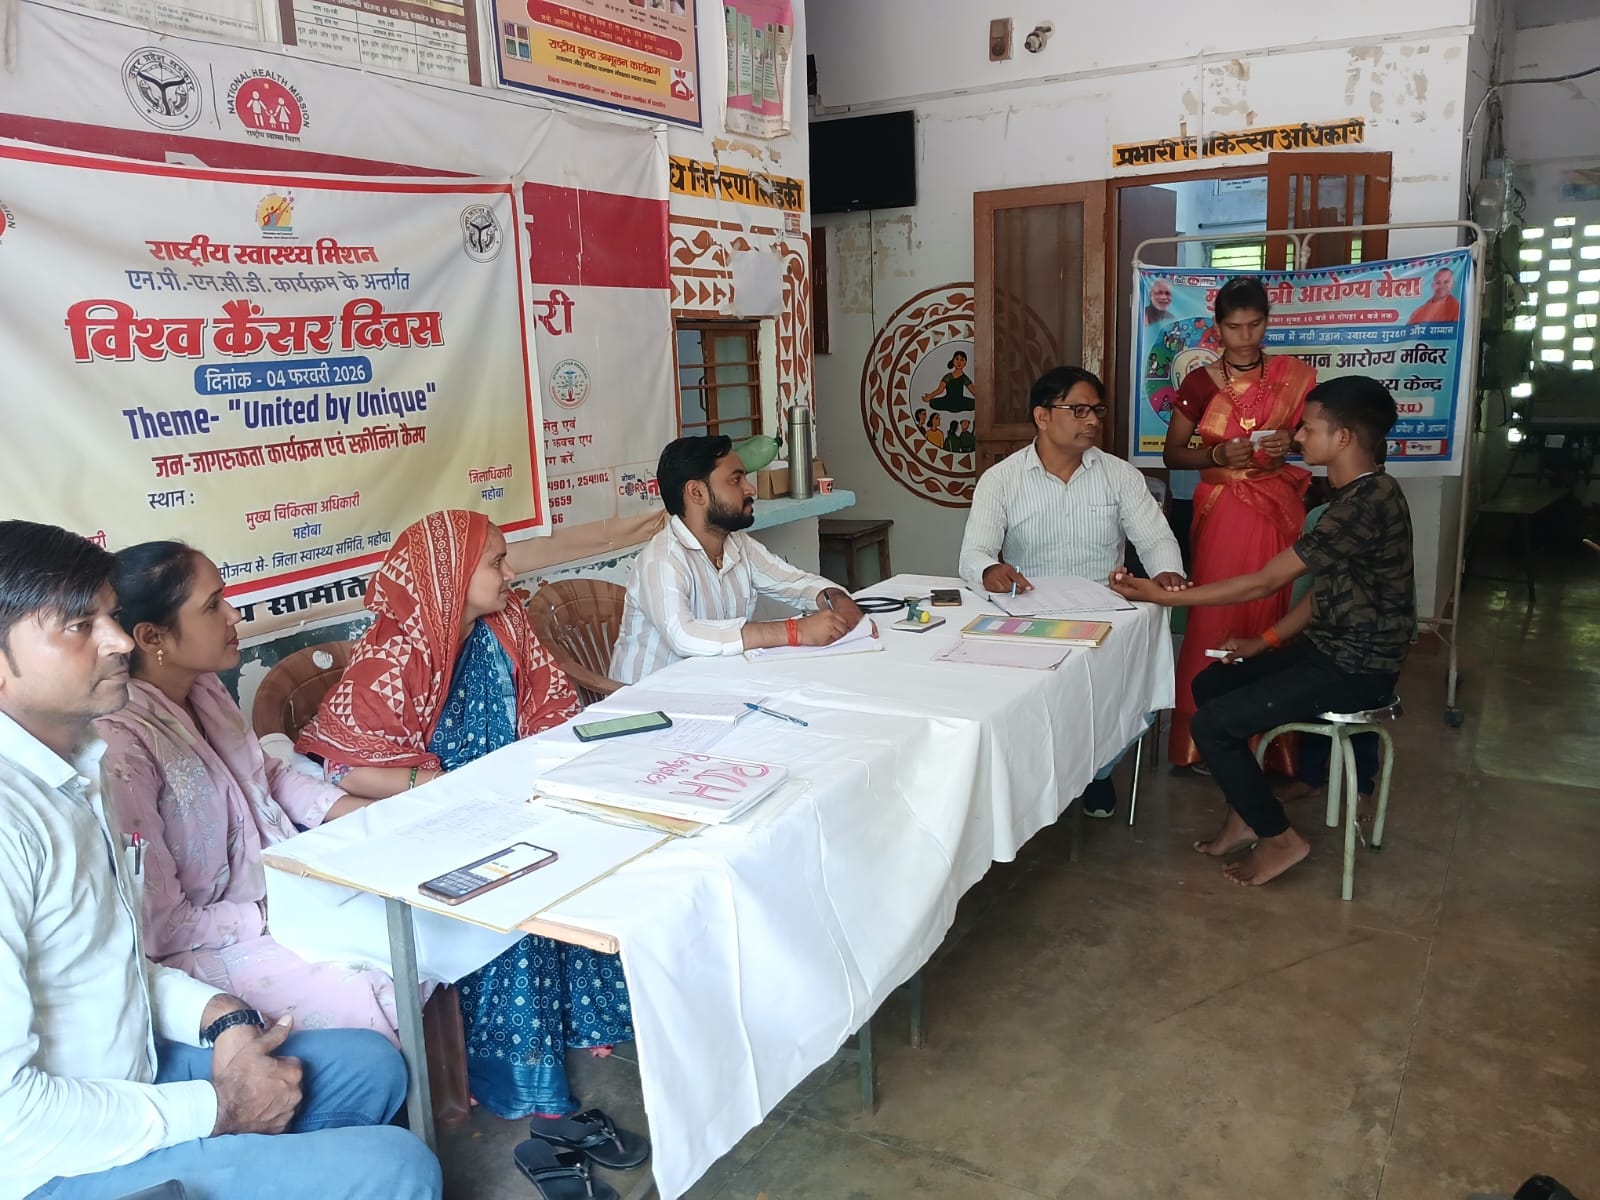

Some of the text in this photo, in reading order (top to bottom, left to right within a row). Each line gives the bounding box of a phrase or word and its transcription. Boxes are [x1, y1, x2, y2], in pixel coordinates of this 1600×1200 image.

[228, 68, 310, 128] NATIONAL HEALTH MISSION
[1117, 138, 1179, 166] प्रभारी
[145, 234, 380, 267] राष्ट्रीय स्वास्थ्य मिशन
[125, 267, 411, 293] एन.पी.-एन.सी.डी. कार्यक्रम के अन्तर्गत
[1297, 270, 1373, 304] आरोग्य
[1376, 270, 1423, 299] मेला
[64, 297, 444, 362] विश्व कैंसर दिवस
[1336, 349, 1397, 369] आरोग्य
[1400, 343, 1449, 365] मन्दिर
[204, 368, 252, 392] दिनांक
[267, 370, 286, 387] 04
[288, 362, 330, 385] फरवरी
[333, 364, 366, 382] 2026
[1403, 375, 1445, 393] केन्द्र
[122, 381, 436, 440] Theme- "United by Unique"
[561, 416, 576, 432] एवं
[265, 435, 325, 464] कार्यक्रम
[326, 430, 348, 457] एवं
[348, 422, 400, 454] स्क्रीनिंग
[401, 423, 426, 447] कैम्प
[552, 437, 576, 448] कवच
[468, 463, 513, 484] जिलाधिकारी
[147, 489, 186, 510] स्थान
[481, 485, 504, 501] महोबा
[245, 491, 361, 531] मुख्य चिकित्सा अधिकारी
[292, 523, 322, 540] महोबा
[272, 552, 297, 569] जिला
[300, 544, 334, 563] स्वास्थ्य
[335, 537, 366, 554] समिति,
[367, 529, 392, 546] महोबा
